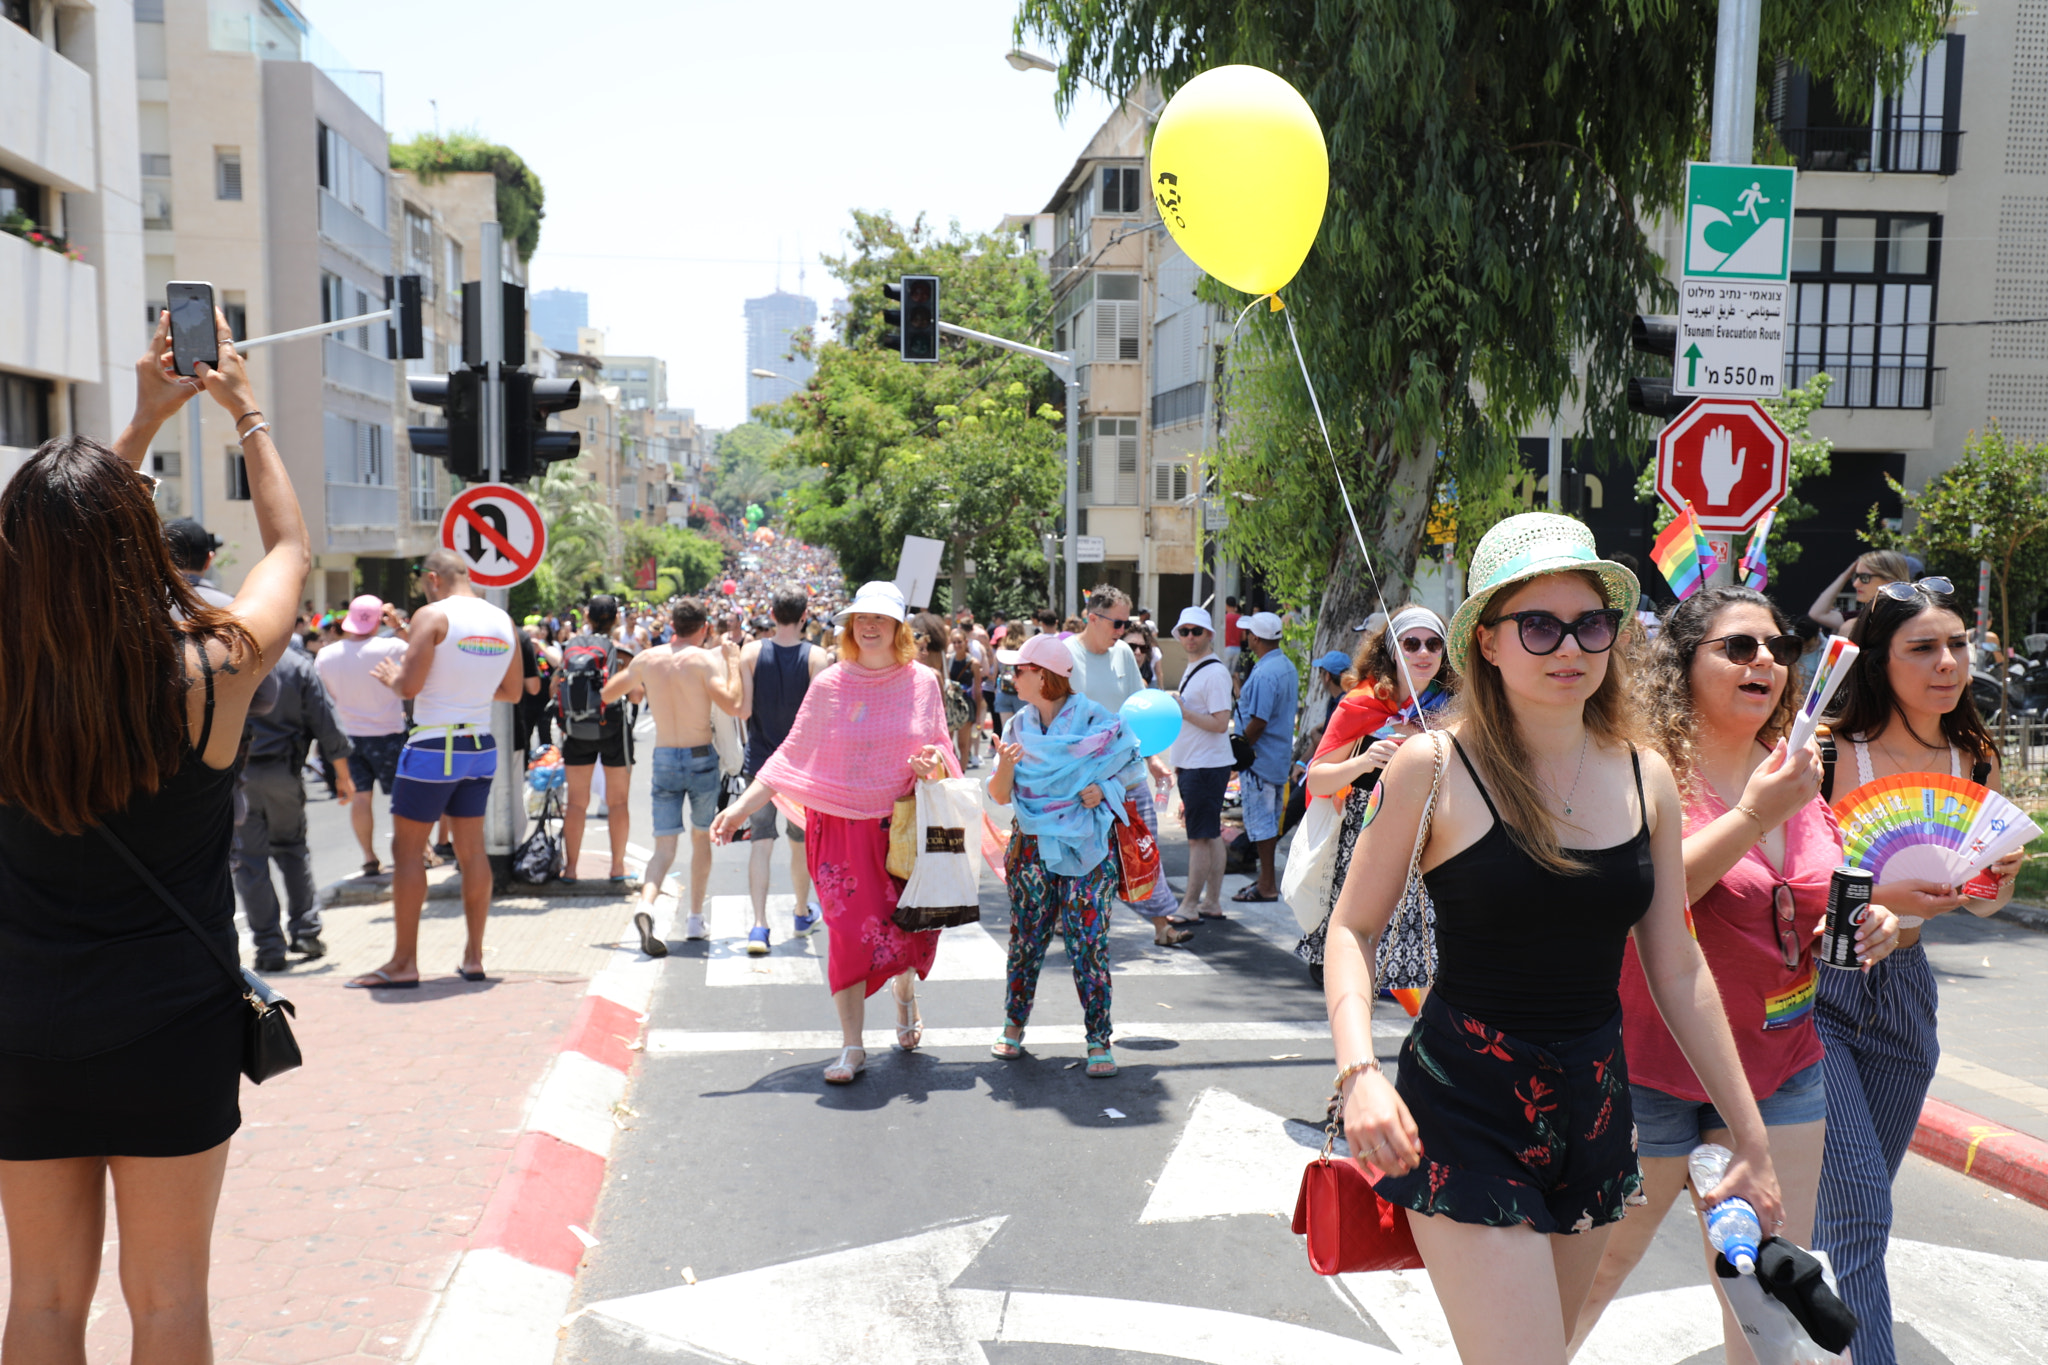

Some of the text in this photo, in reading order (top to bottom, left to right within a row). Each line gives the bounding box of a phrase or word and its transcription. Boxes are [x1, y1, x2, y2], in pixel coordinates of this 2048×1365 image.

[1687, 286, 1715, 298] מילוט
[1684, 324, 1781, 341] Tsunami Evacuation Route
[1724, 366, 1757, 386] 550
[1760, 374, 1774, 386] m
